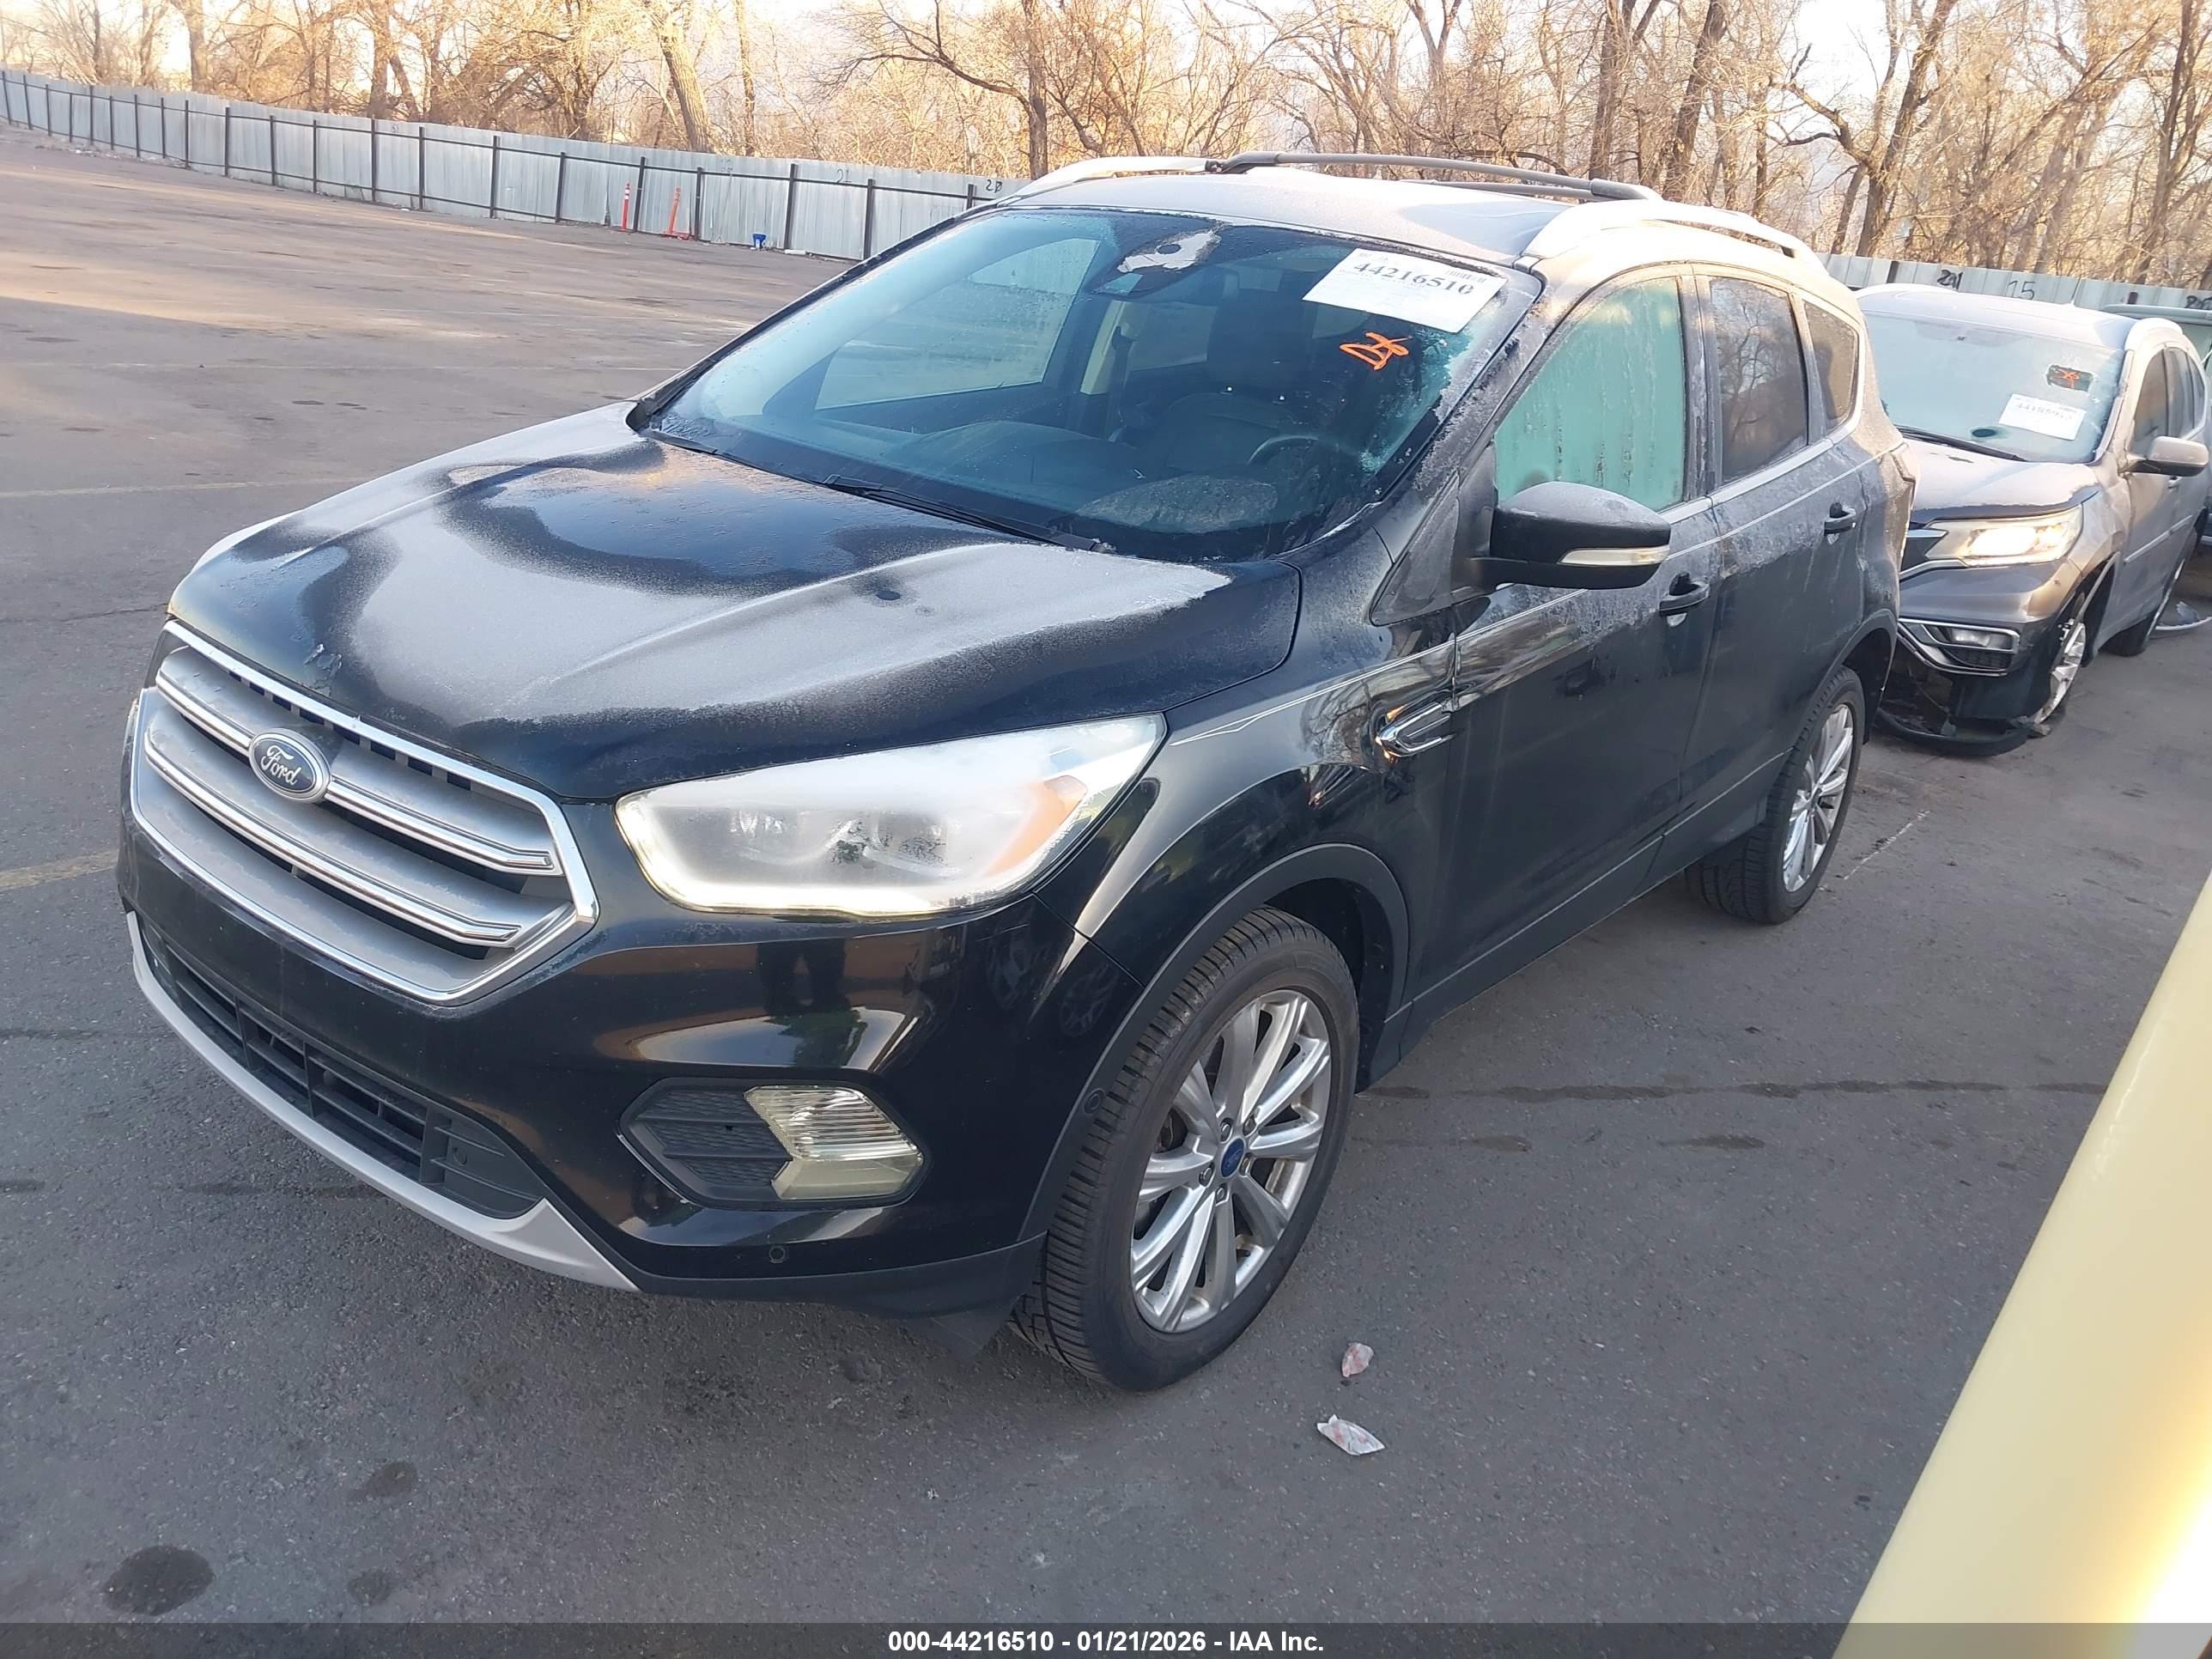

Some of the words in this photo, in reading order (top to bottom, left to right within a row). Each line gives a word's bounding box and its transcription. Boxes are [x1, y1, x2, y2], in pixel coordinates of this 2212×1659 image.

[1352, 263, 1474, 294] 44216510
[2008, 280, 2036, 301] 15
[260, 744, 302, 786] Ford
